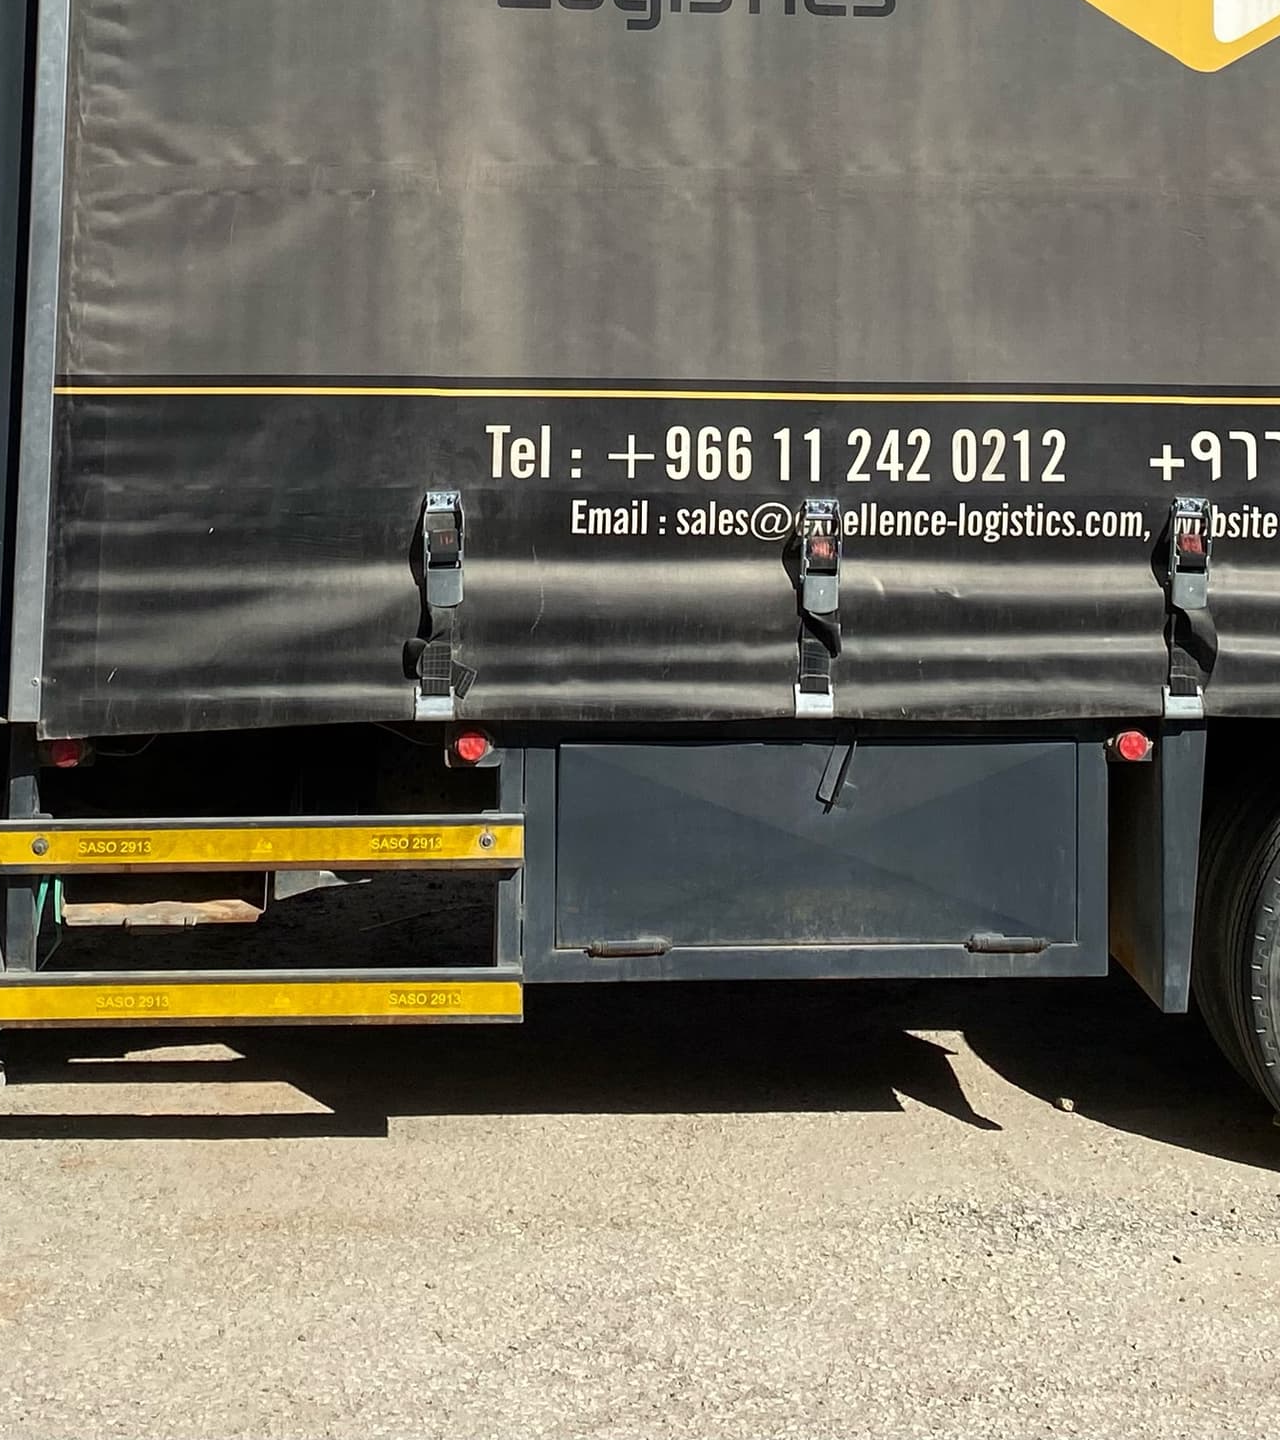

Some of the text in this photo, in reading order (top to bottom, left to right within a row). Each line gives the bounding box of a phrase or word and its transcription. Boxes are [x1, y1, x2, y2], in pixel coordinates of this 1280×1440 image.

[485, 425, 551, 479] Tel
[773, 427, 821, 482] 11
[846, 428, 932, 482] 242
[952, 428, 1067, 483] 0212
[571, 499, 648, 536] Email
[78, 841, 152, 854] SASO 2913
[370, 836, 443, 849] SASO 2913
[95, 995, 169, 1008] SASO 2913
[388, 993, 462, 1005] SASO 2913
